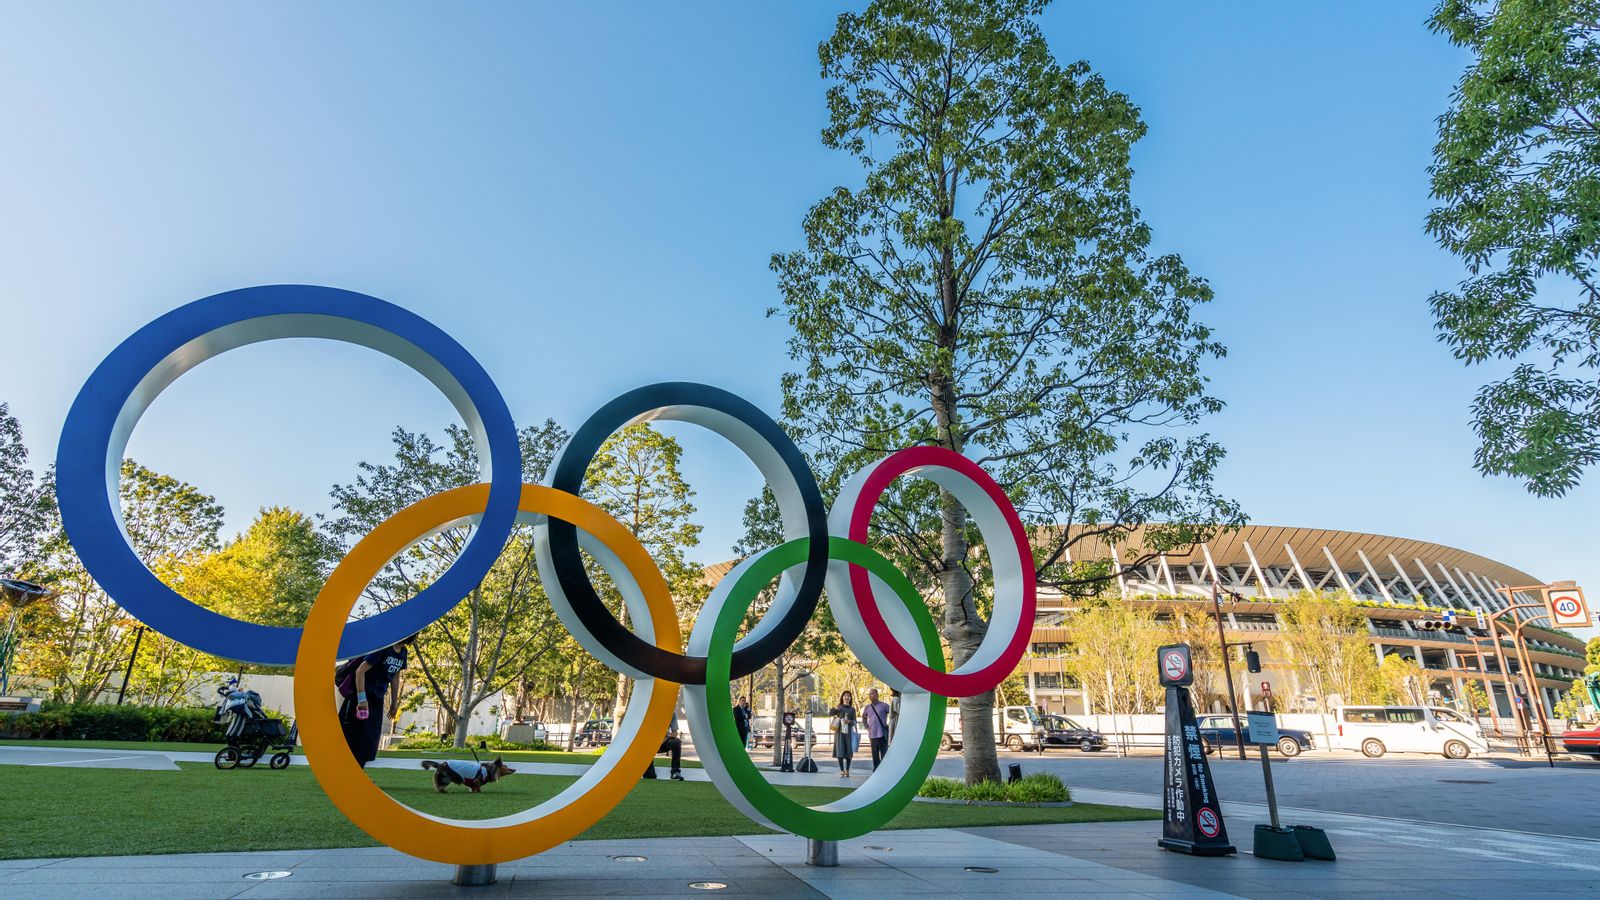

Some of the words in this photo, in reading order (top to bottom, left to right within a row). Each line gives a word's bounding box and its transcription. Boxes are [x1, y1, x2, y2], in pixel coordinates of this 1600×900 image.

[1560, 602, 1575, 612] 40
[1184, 725, 1201, 759] 禁煙
[1172, 735, 1184, 821] 防犯カメラ作動中
[1200, 774, 1209, 803] Smoking
